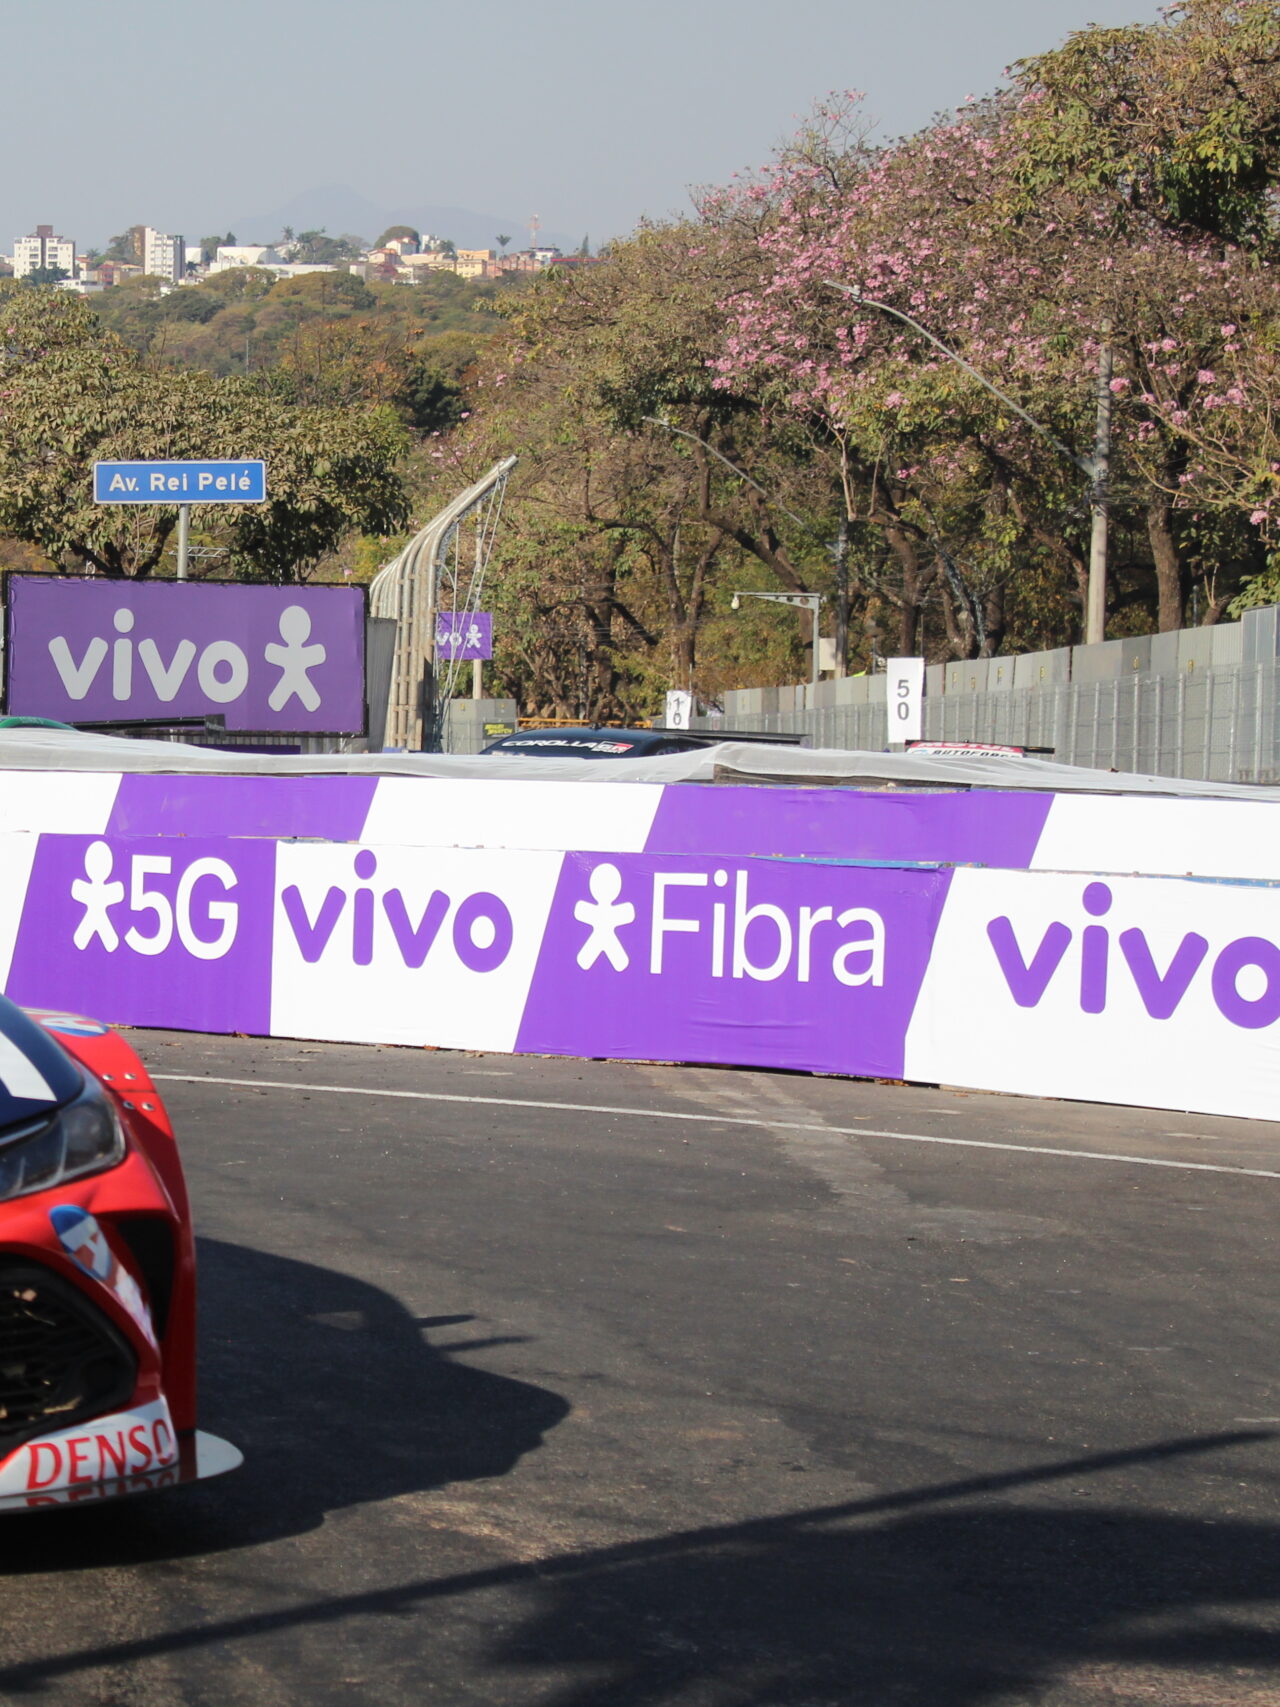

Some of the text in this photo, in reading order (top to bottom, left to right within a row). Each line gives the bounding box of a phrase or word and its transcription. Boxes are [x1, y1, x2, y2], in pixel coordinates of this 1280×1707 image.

[109, 470, 252, 492] Av. Rei Pelé
[48, 607, 250, 703] vivo
[501, 740, 598, 748] COROLLA
[124, 854, 239, 960] 5G
[281, 849, 514, 974] vivo
[650, 868, 887, 988] Fibra
[986, 881, 1280, 1031] vivo
[26, 1418, 174, 1491] DENSO
